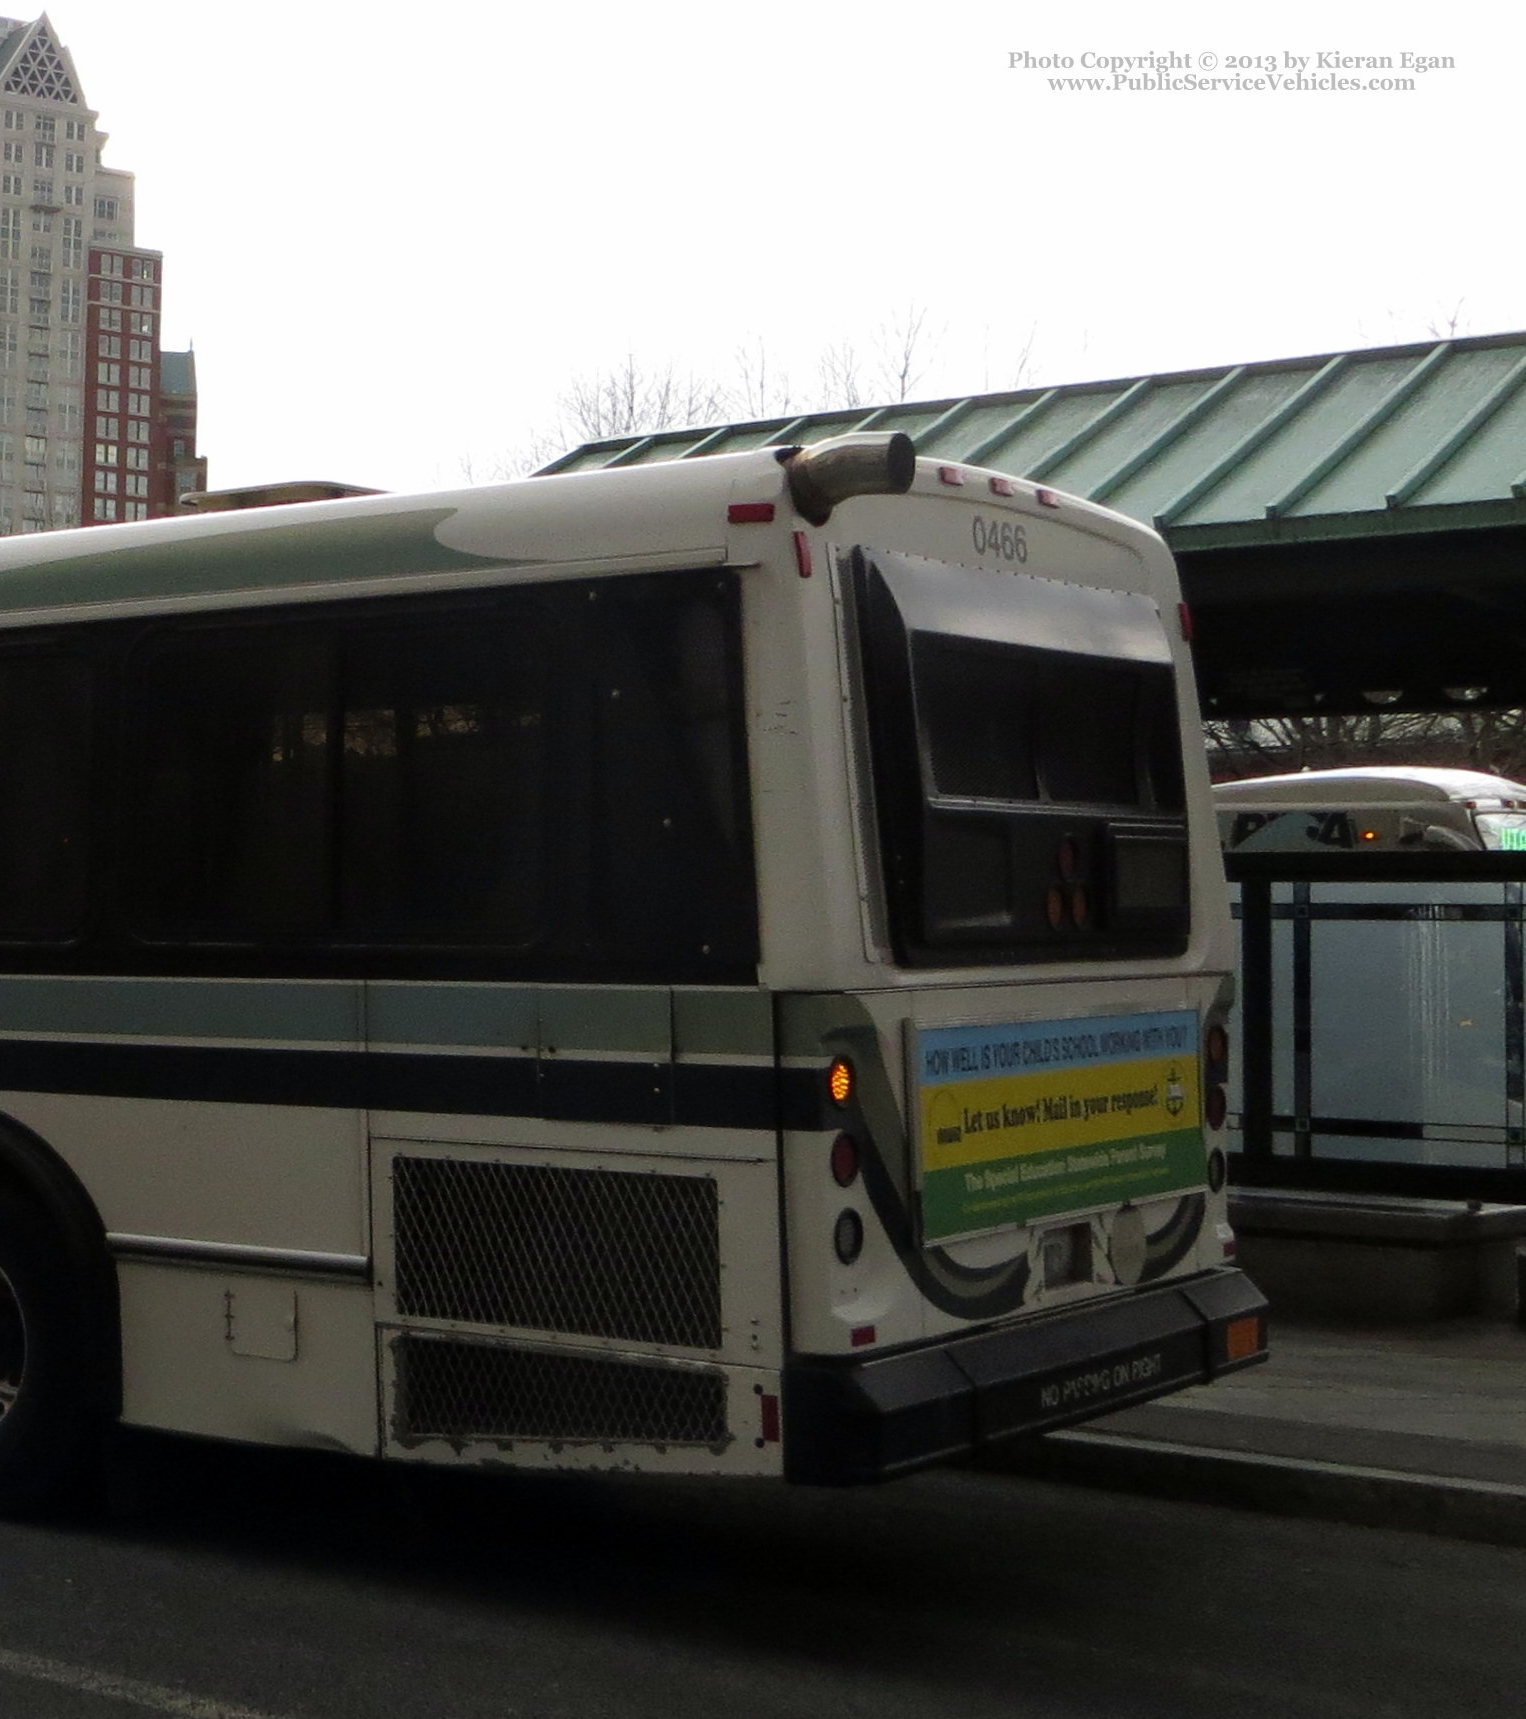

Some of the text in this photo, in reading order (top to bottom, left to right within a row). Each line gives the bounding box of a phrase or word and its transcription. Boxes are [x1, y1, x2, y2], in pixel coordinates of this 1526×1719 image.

[973, 516, 1027, 563] 0466
[925, 1048, 949, 1075] HOW
[952, 1046, 979, 1072] WELL
[981, 1044, 992, 1071] IS
[994, 1041, 1020, 1068] YOUR
[1023, 1037, 1060, 1065] CHILD'S
[1062, 1034, 1099, 1060] SCHOOL
[1100, 1030, 1140, 1055] WORKING
[963, 1084, 1159, 1133] Let us know! Mail in your response!
[1040, 1384, 1059, 1408] NO
[1113, 1362, 1130, 1388] ON
